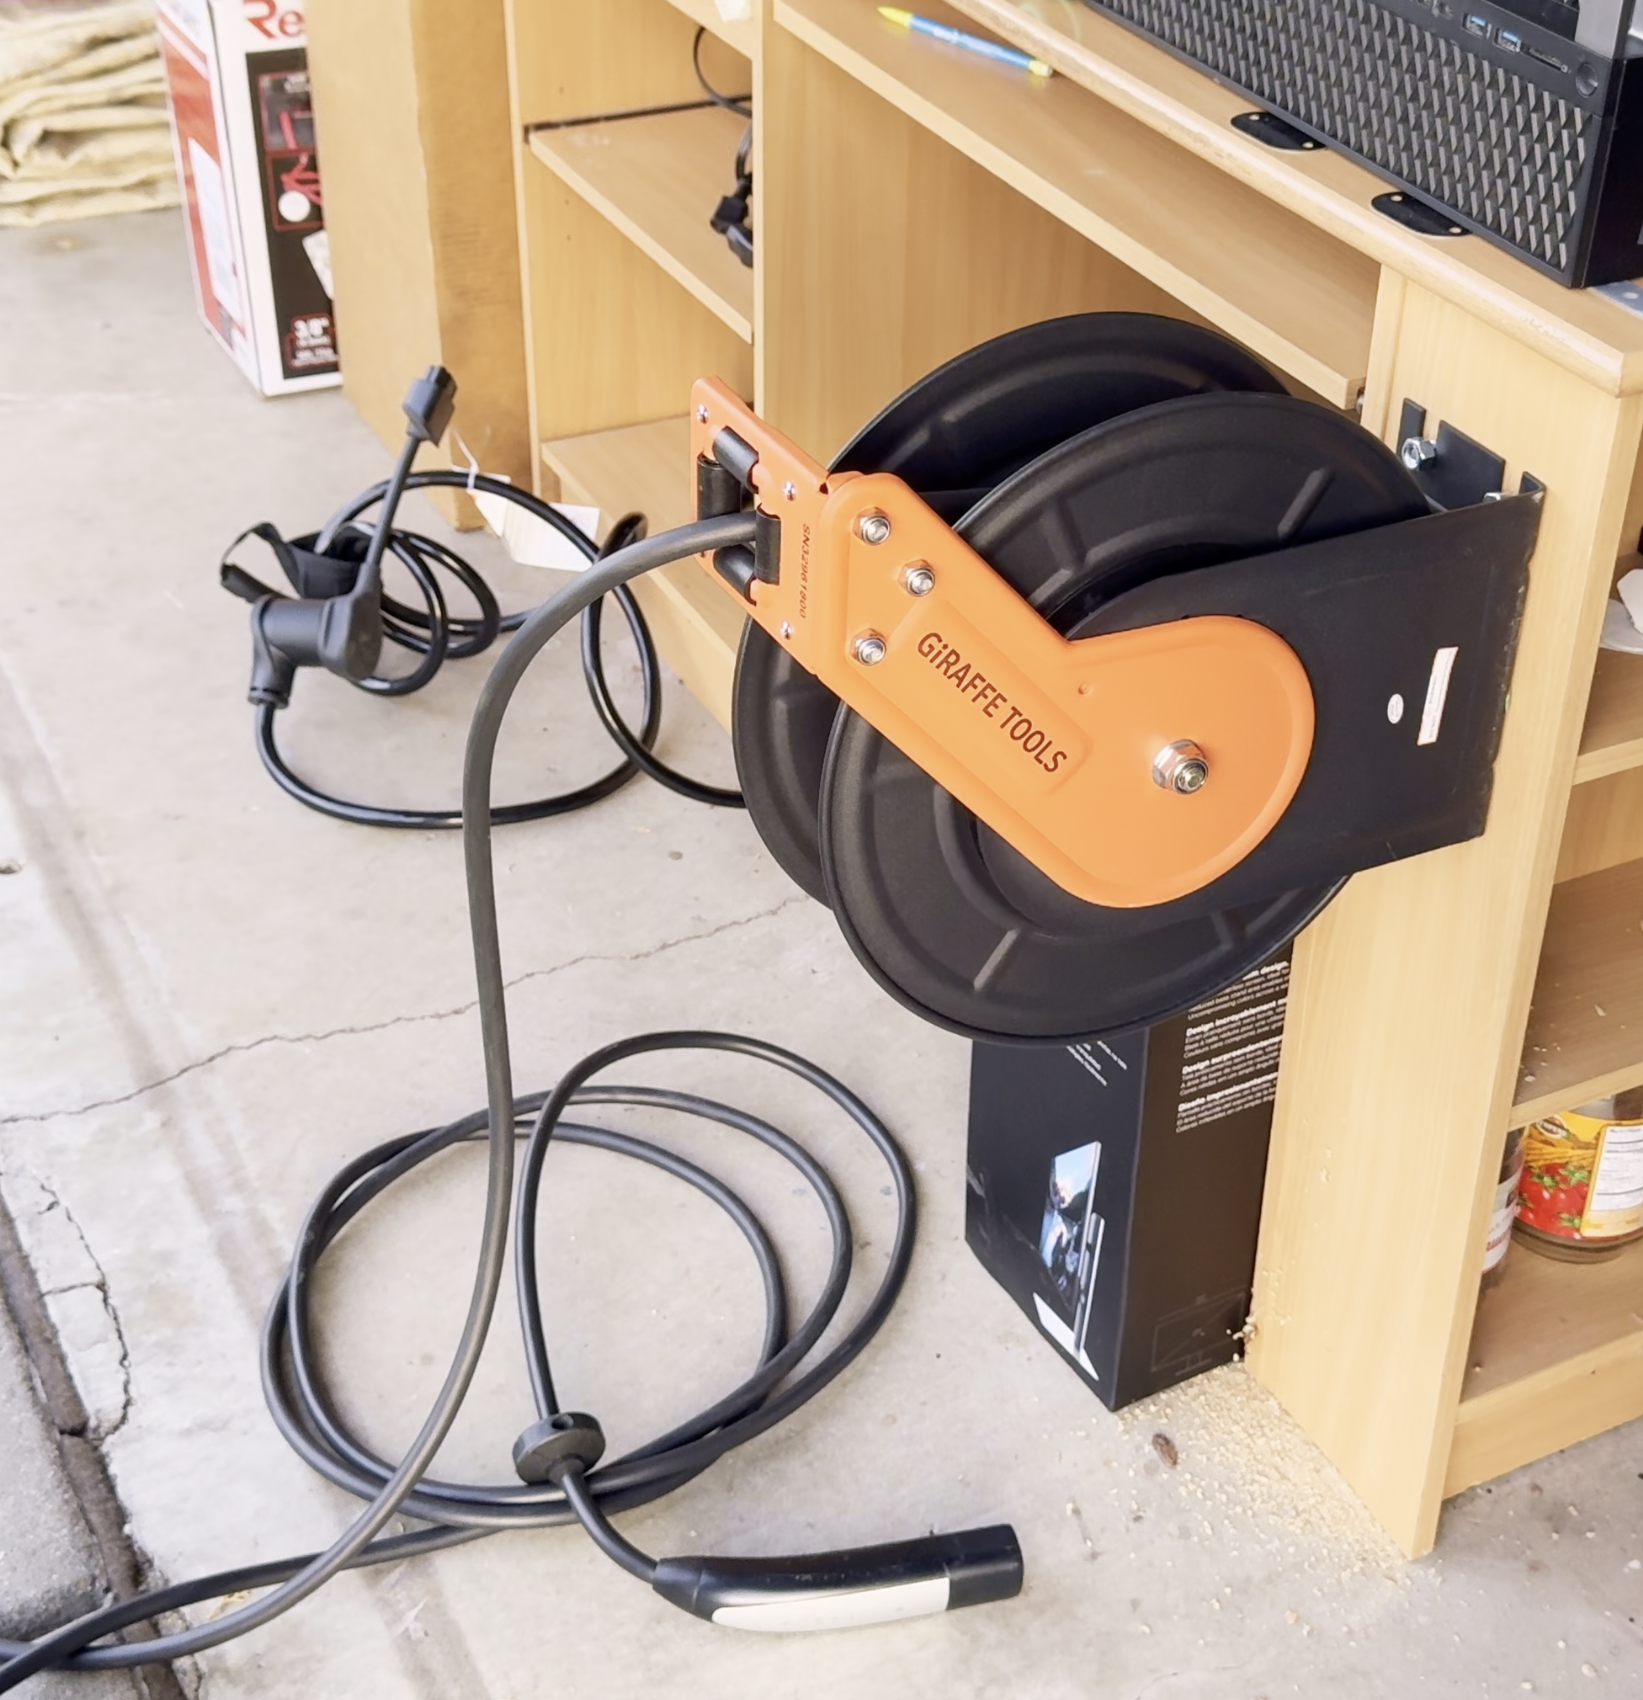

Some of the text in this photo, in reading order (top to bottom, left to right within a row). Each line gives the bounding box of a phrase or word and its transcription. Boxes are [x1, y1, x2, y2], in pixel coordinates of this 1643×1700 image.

[799, 523, 811, 619] SN32961800
[917, 632, 1068, 773] GiRAFFE TOOLS
[1186, 1021, 1215, 1037] Design
[1182, 1059, 1210, 1075] Design
